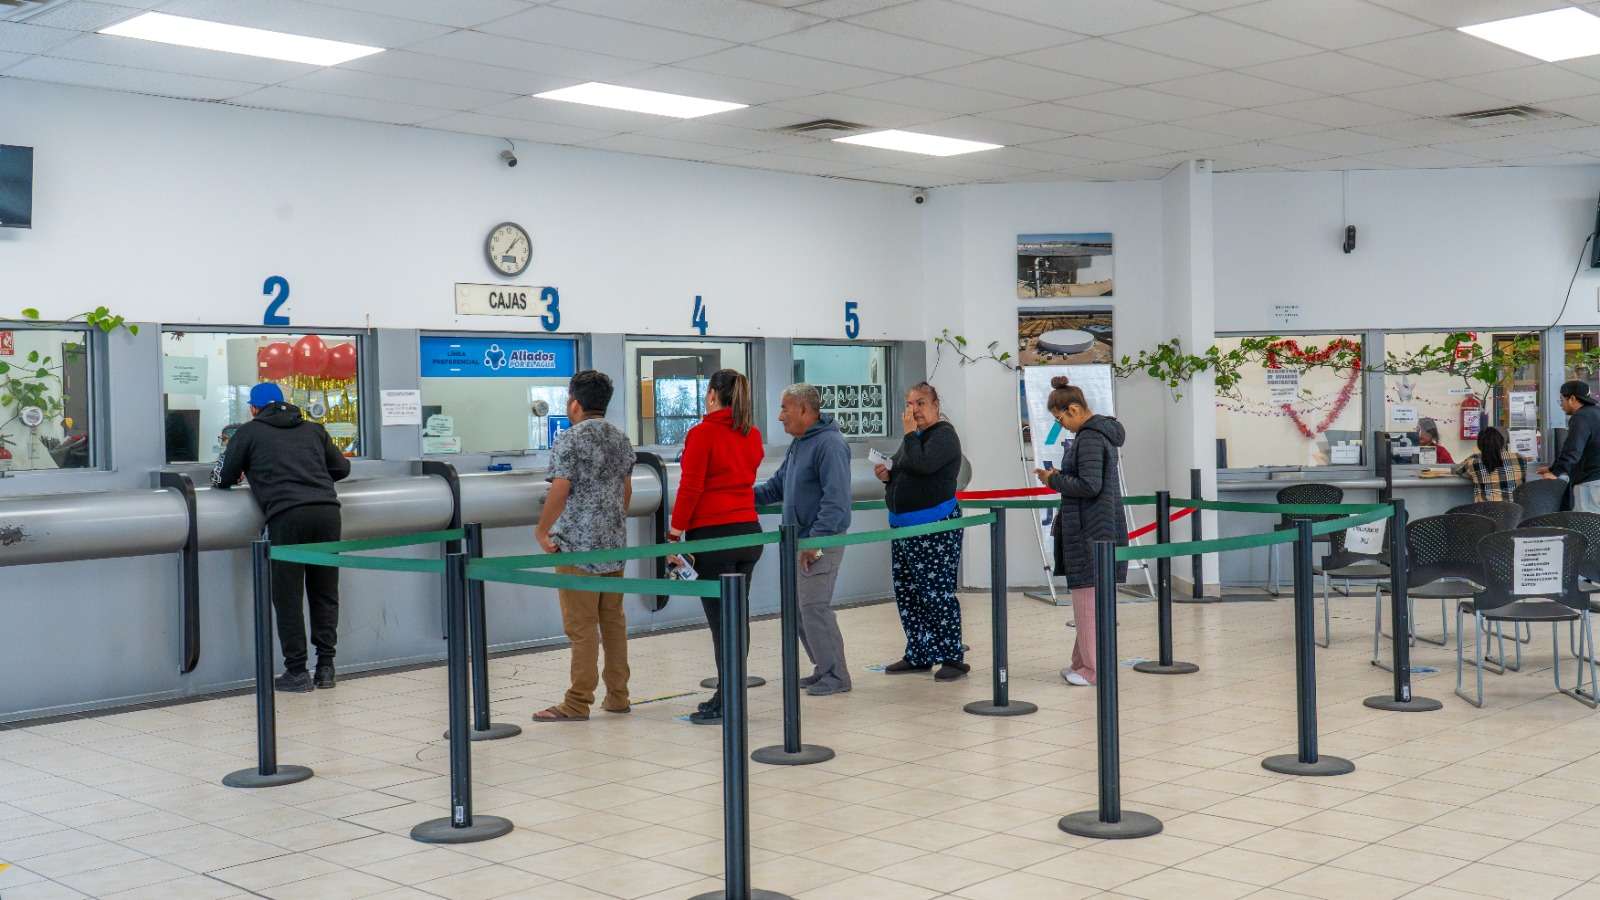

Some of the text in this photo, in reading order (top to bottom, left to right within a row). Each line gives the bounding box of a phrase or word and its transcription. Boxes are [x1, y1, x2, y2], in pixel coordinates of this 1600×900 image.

[263, 275, 290, 326] 2
[489, 291, 527, 310] CAJAS
[540, 286, 560, 332] 3
[692, 295, 708, 335] 4
[845, 301, 860, 339] 5
[511, 351, 555, 361] Aliados
